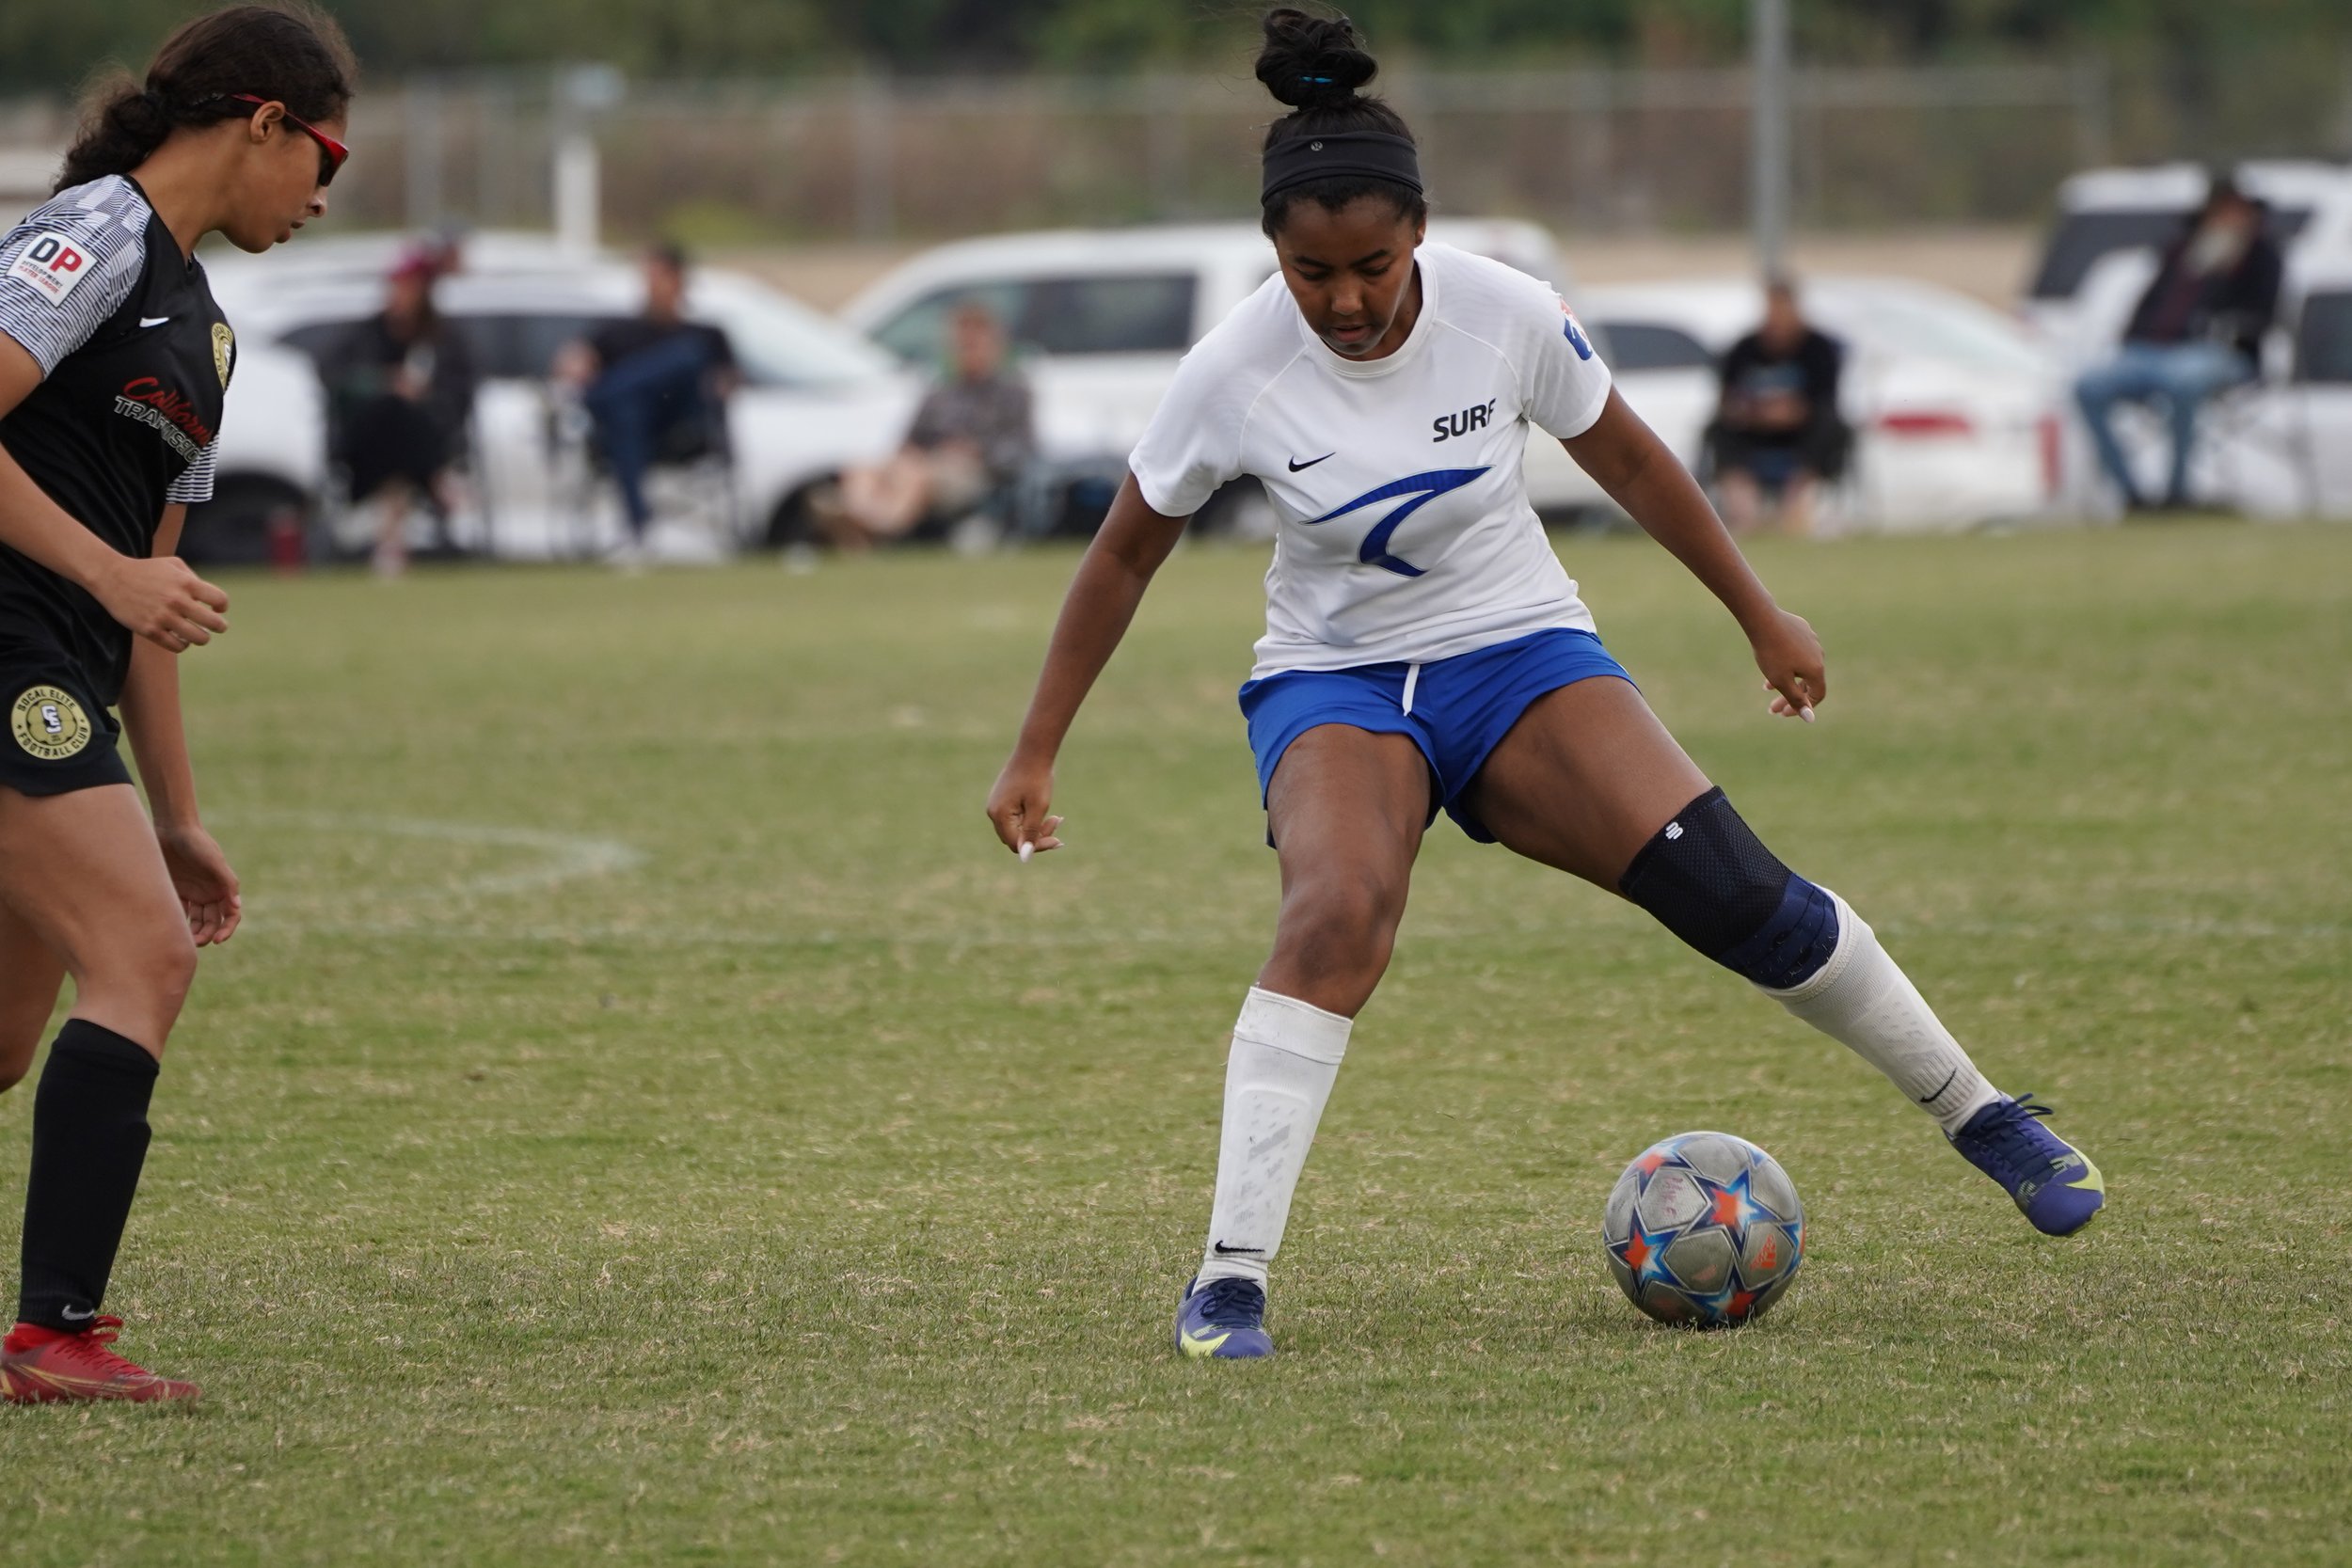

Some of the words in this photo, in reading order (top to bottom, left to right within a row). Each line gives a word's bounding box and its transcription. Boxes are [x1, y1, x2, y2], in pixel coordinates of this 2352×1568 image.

[28, 237, 83, 273] DP
[1433, 397, 1497, 443] SURF
[17, 689, 46, 712] SOCAL
[49, 689, 76, 709] ELITE
[18, 732, 72, 757] FOOTBALL
[71, 727, 88, 750] CLUB
